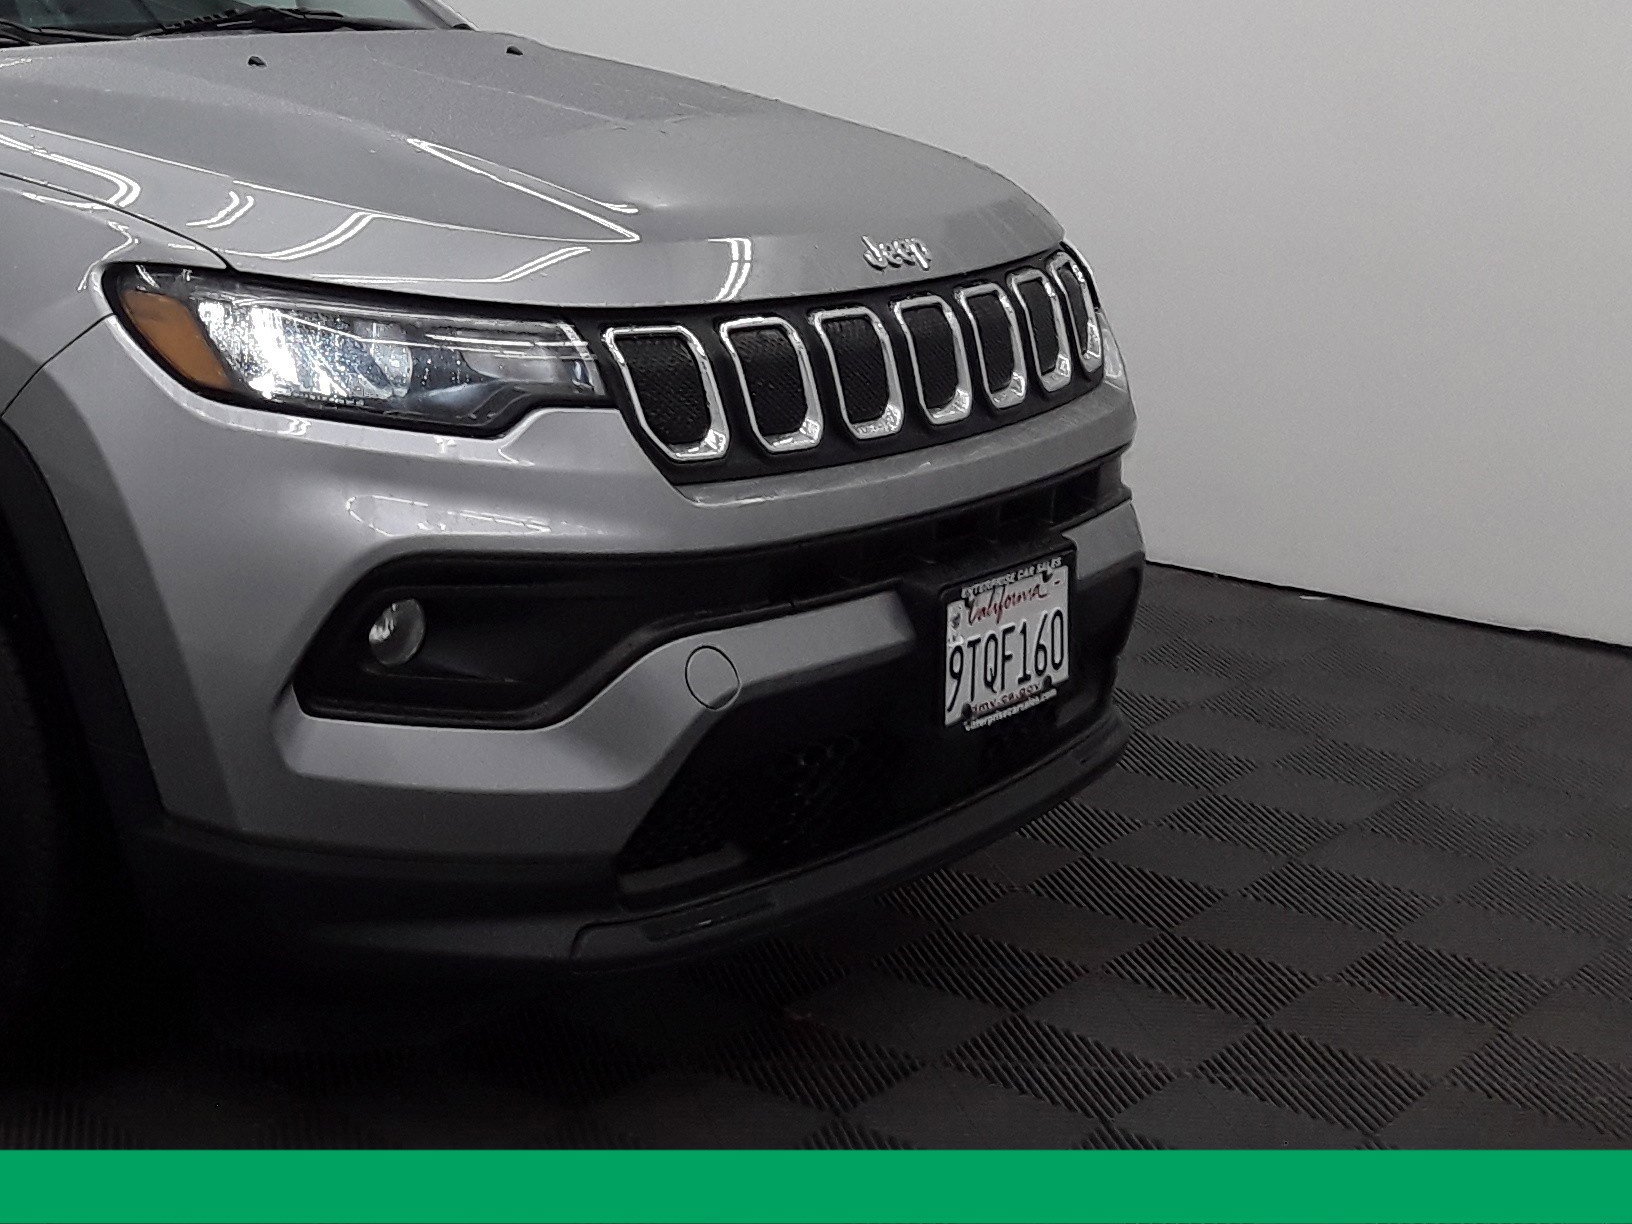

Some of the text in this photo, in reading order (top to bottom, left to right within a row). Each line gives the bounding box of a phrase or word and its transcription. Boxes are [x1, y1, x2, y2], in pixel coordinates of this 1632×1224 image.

[861, 234, 932, 270] Jeep
[967, 583, 1049, 626] California
[947, 608, 1065, 713] 9TQF160
